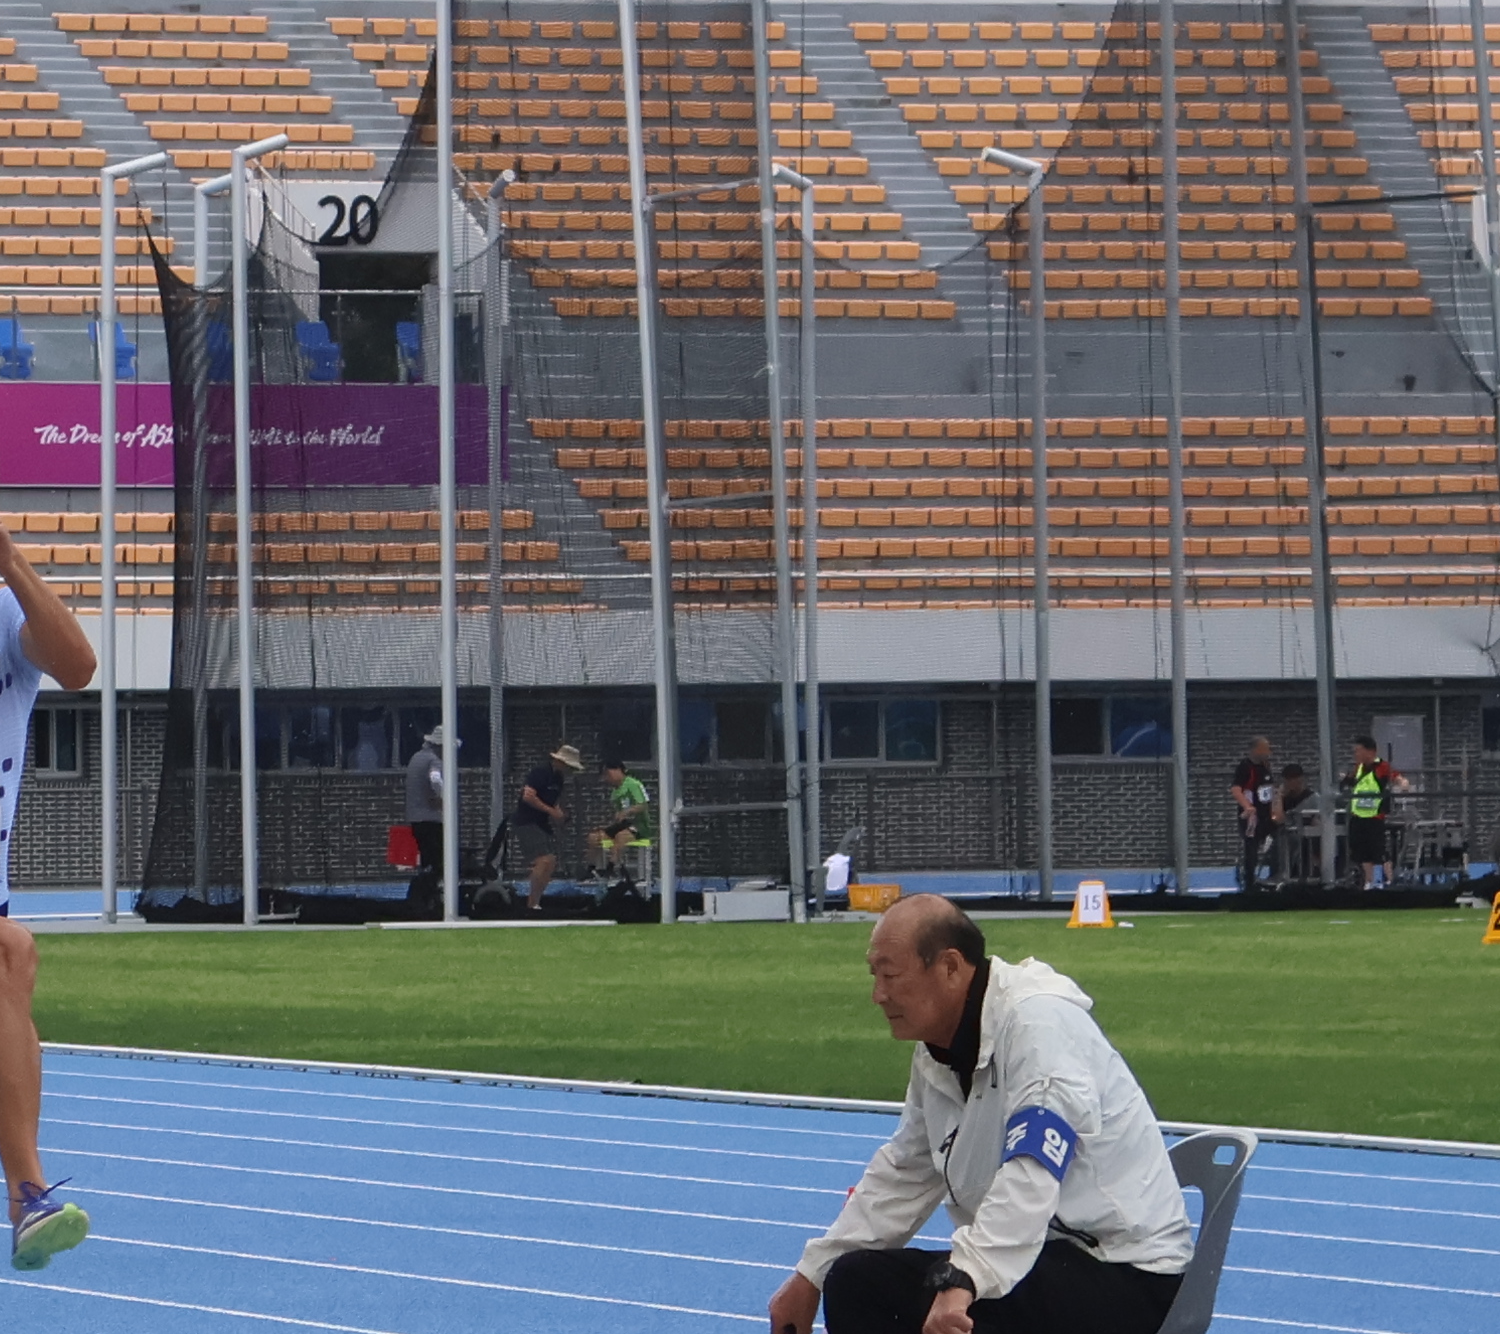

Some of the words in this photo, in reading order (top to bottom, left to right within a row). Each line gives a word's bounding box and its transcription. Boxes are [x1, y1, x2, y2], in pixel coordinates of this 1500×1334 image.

[318, 194, 379, 245] 20
[34, 424, 68, 444] The
[122, 424, 146, 448] of
[328, 423, 385, 446] World
[1083, 894, 1101, 910] 15
